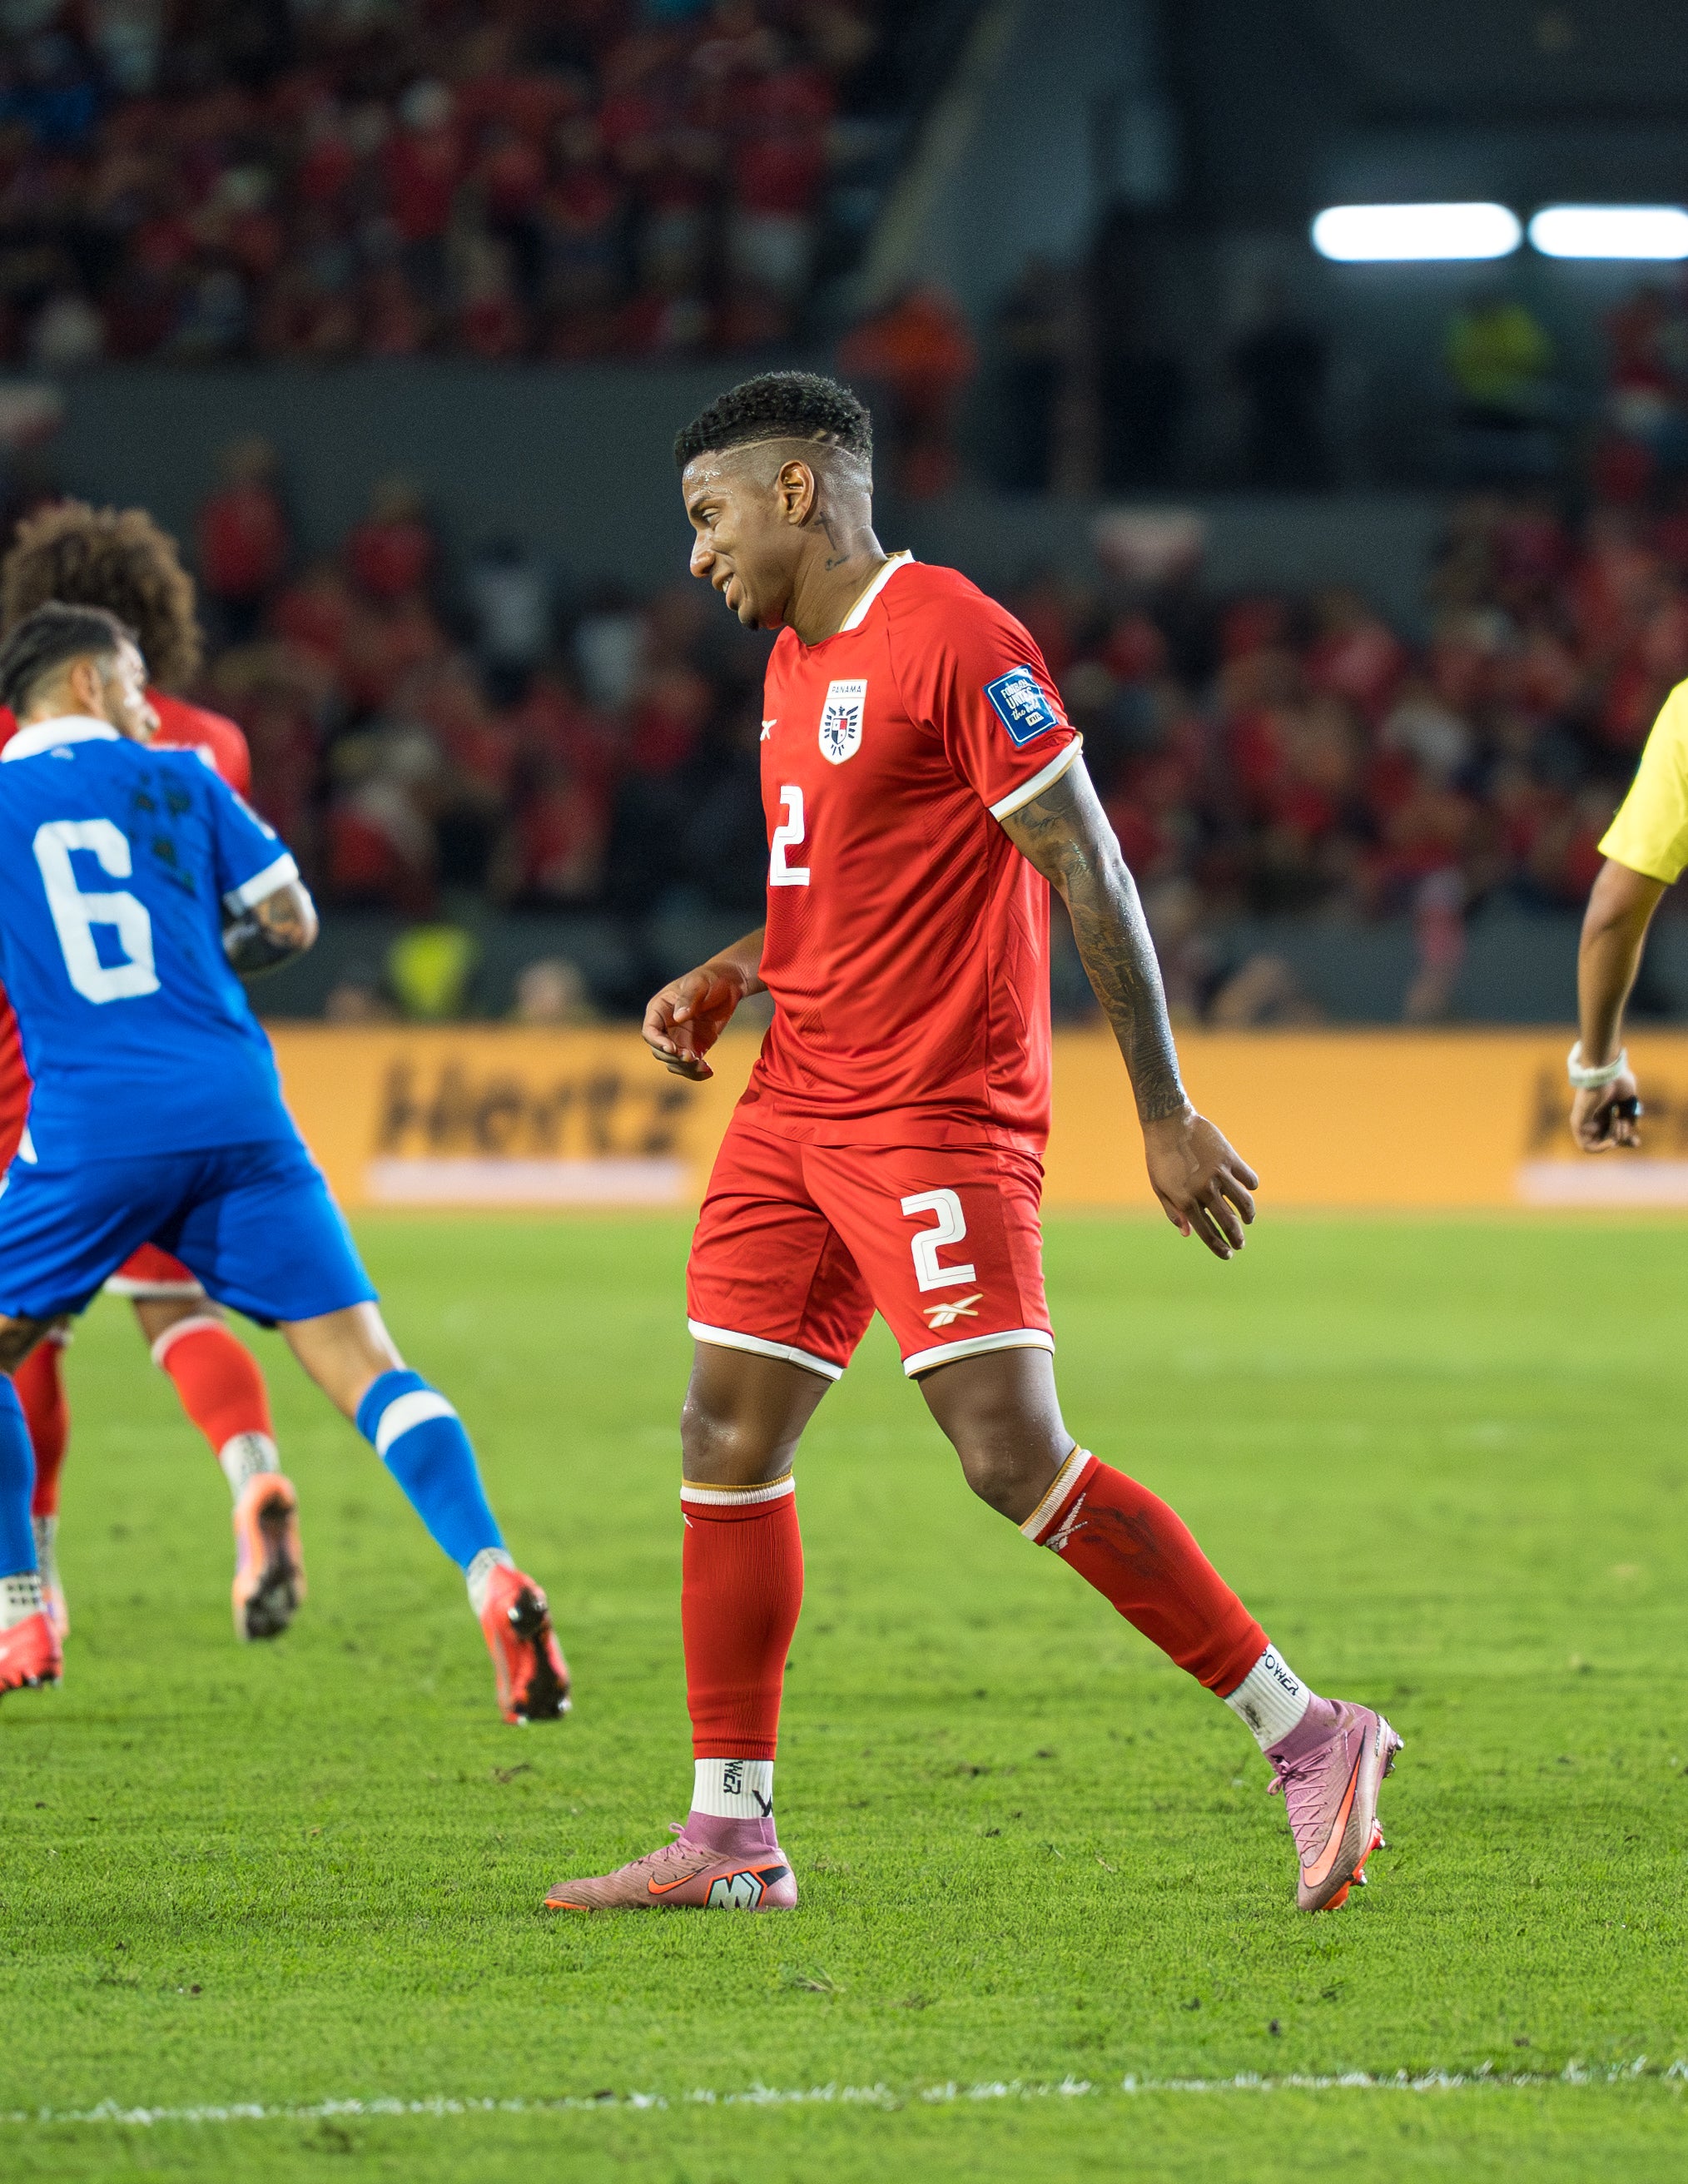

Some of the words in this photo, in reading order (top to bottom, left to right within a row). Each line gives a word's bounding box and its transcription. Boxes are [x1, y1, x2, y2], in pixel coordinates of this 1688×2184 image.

[832, 685, 861, 693] PANAMA
[770, 785, 811, 886] 2
[33, 818, 161, 1005] 6
[901, 1188, 977, 1292] 2
